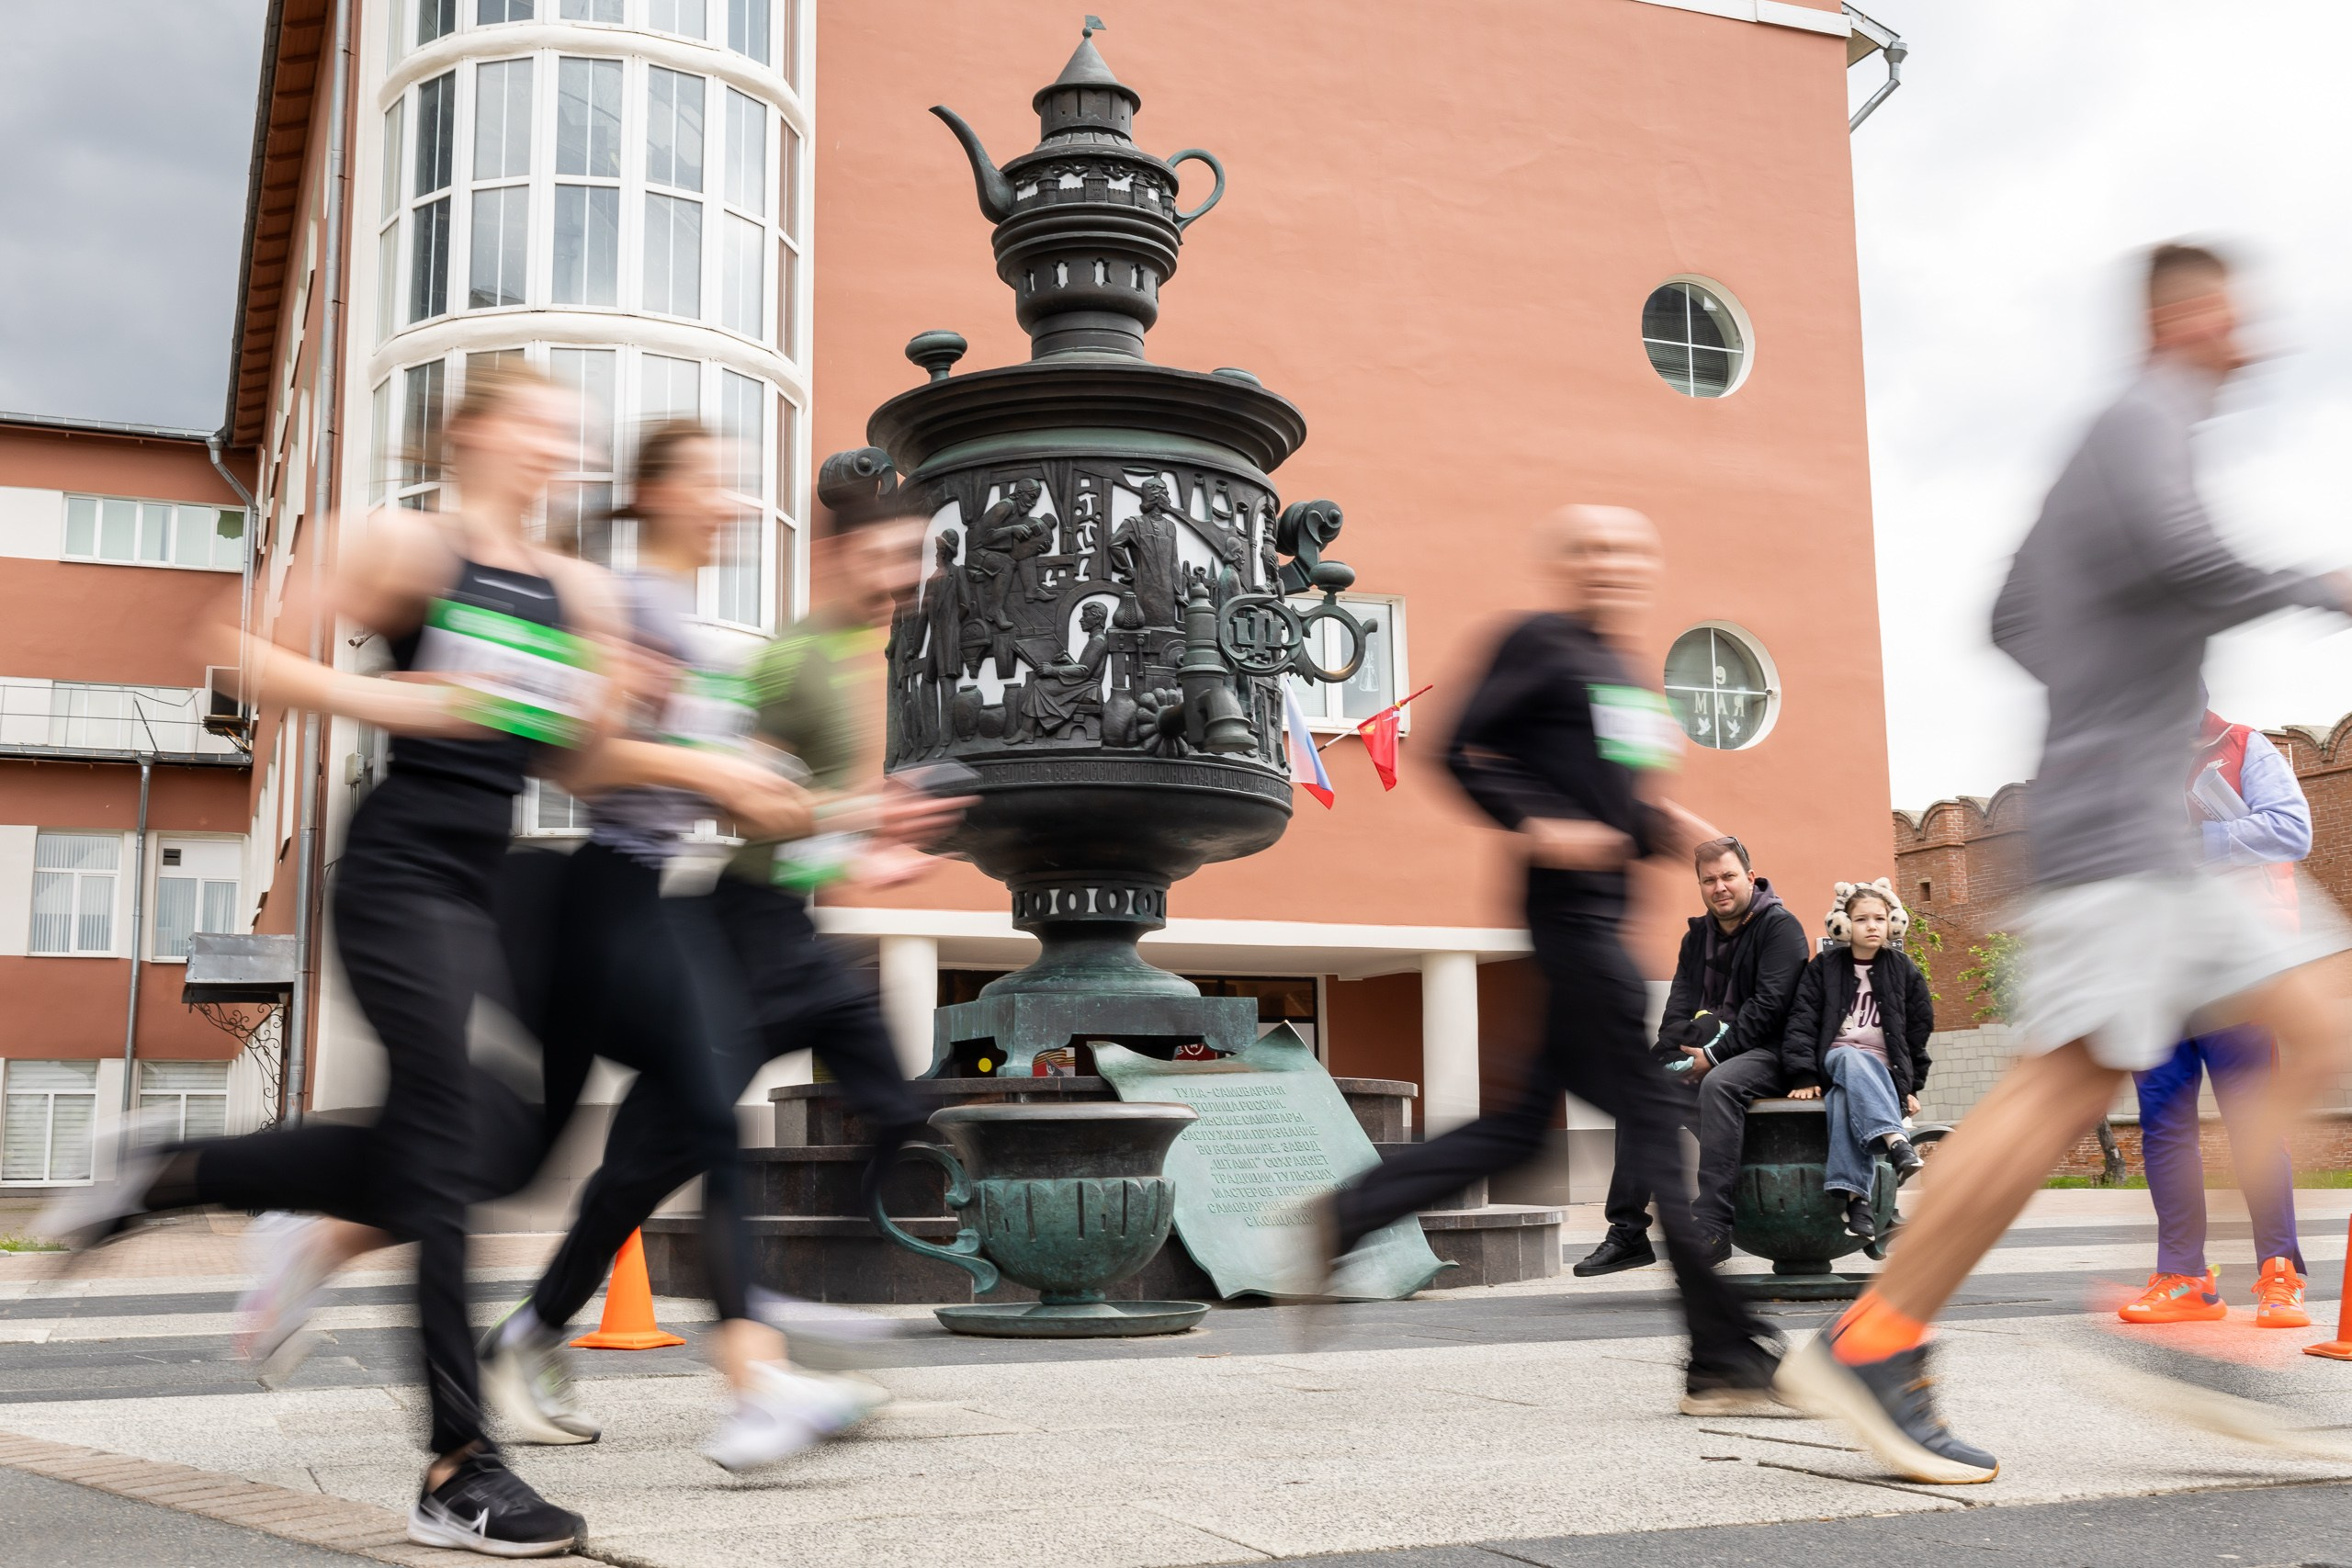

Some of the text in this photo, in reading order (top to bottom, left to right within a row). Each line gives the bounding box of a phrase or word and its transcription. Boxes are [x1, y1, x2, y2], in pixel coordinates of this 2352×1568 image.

[1714, 665, 1726, 685] 9
[1693, 691, 1745, 717] МАЯ
[1238, 1100, 1286, 1111] РОССИИ.
[1240, 1111, 1306, 1126] САМОВАРЫ
[1180, 1125, 1319, 1141] ЗАСЛУЖИЛИ ПРИЗНАНИЕ
[1196, 1140, 1321, 1156] ВО ВСЁМ МИРЕ. ЗАВОД
[1263, 1155, 1329, 1168] СОХРАНЯЕТ
[1211, 1168, 1337, 1185] ТРАДИЦИИ ТУЛЬСКИХ
[1207, 1201, 1287, 1213] САМОВАРНОЕ
[1244, 1215, 1255, 1227] С
[1252, 1214, 1295, 1227] КОНЦА
